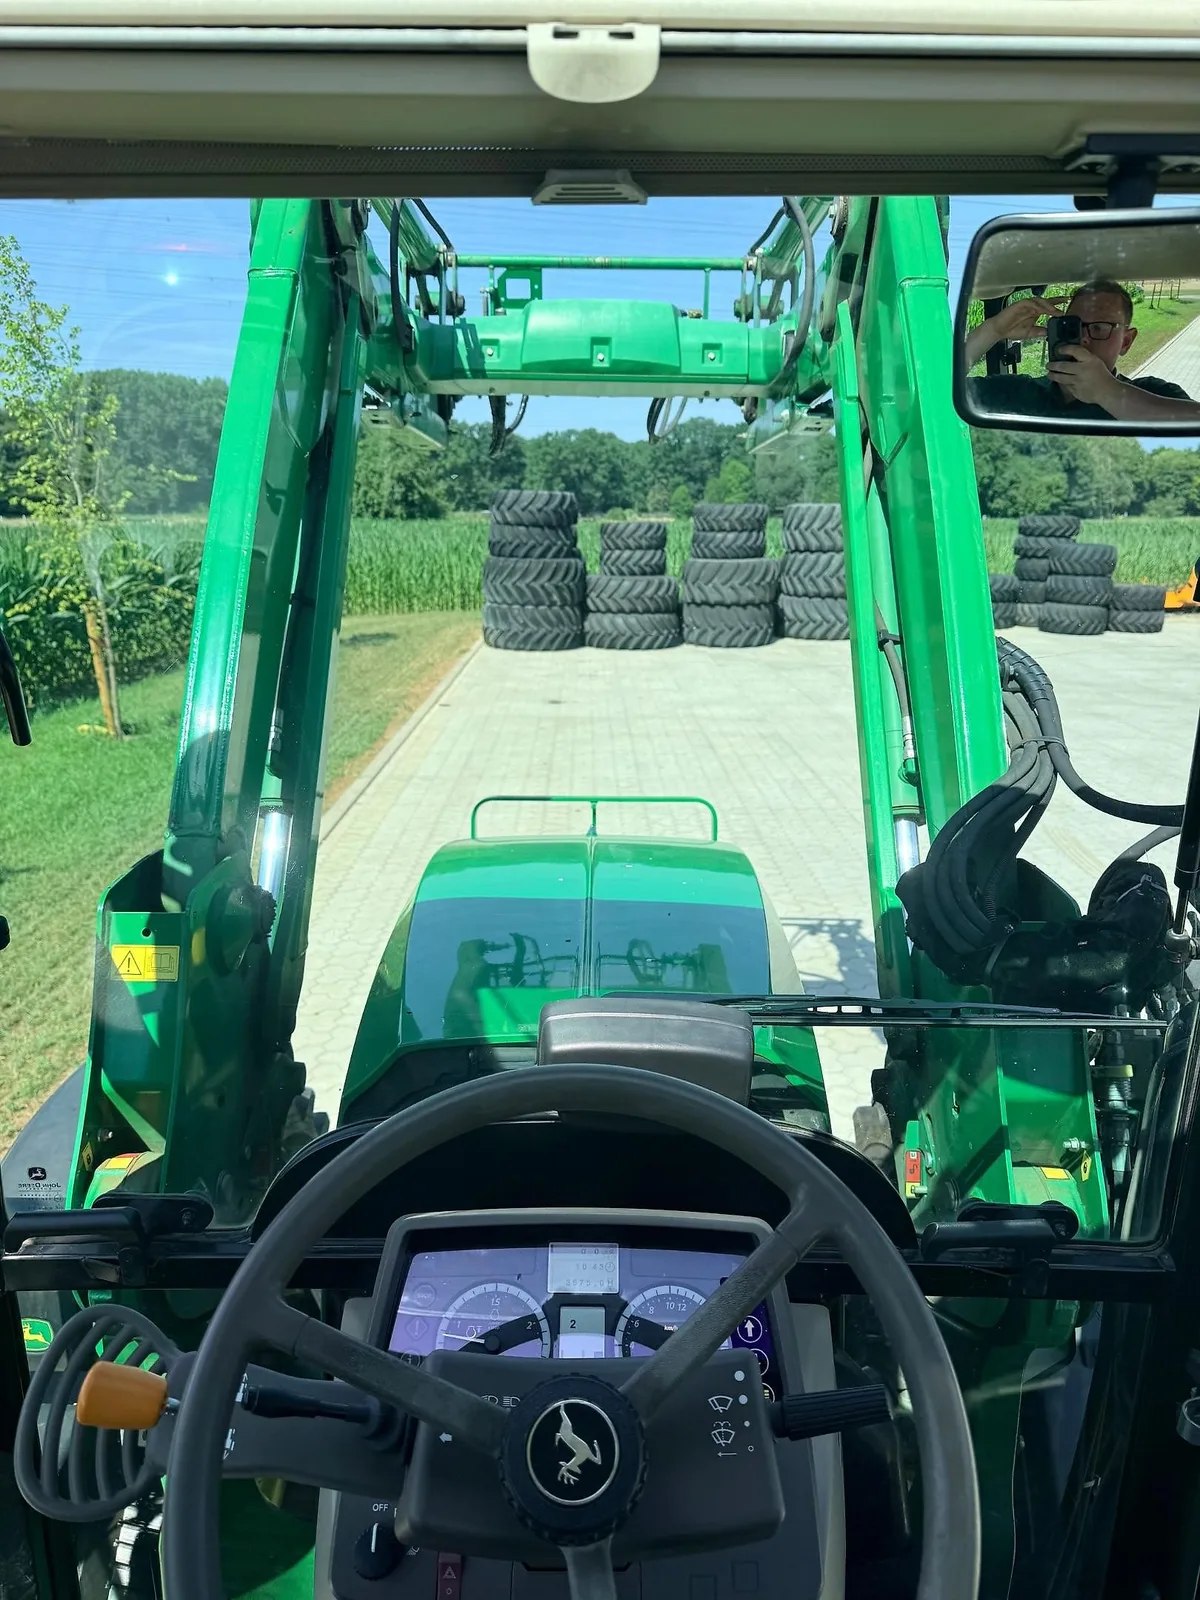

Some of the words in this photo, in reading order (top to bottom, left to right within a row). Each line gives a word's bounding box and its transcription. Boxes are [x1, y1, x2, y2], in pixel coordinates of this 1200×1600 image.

[665, 1301, 676, 1310] 10
[677, 1303, 687, 1312] 12
[648, 1306, 655, 1315] 8
[526, 1321, 533, 1330] 2
[569, 1319, 577, 1329] 2
[634, 1319, 640, 1328] 6
[372, 1503, 389, 1512] OFF
